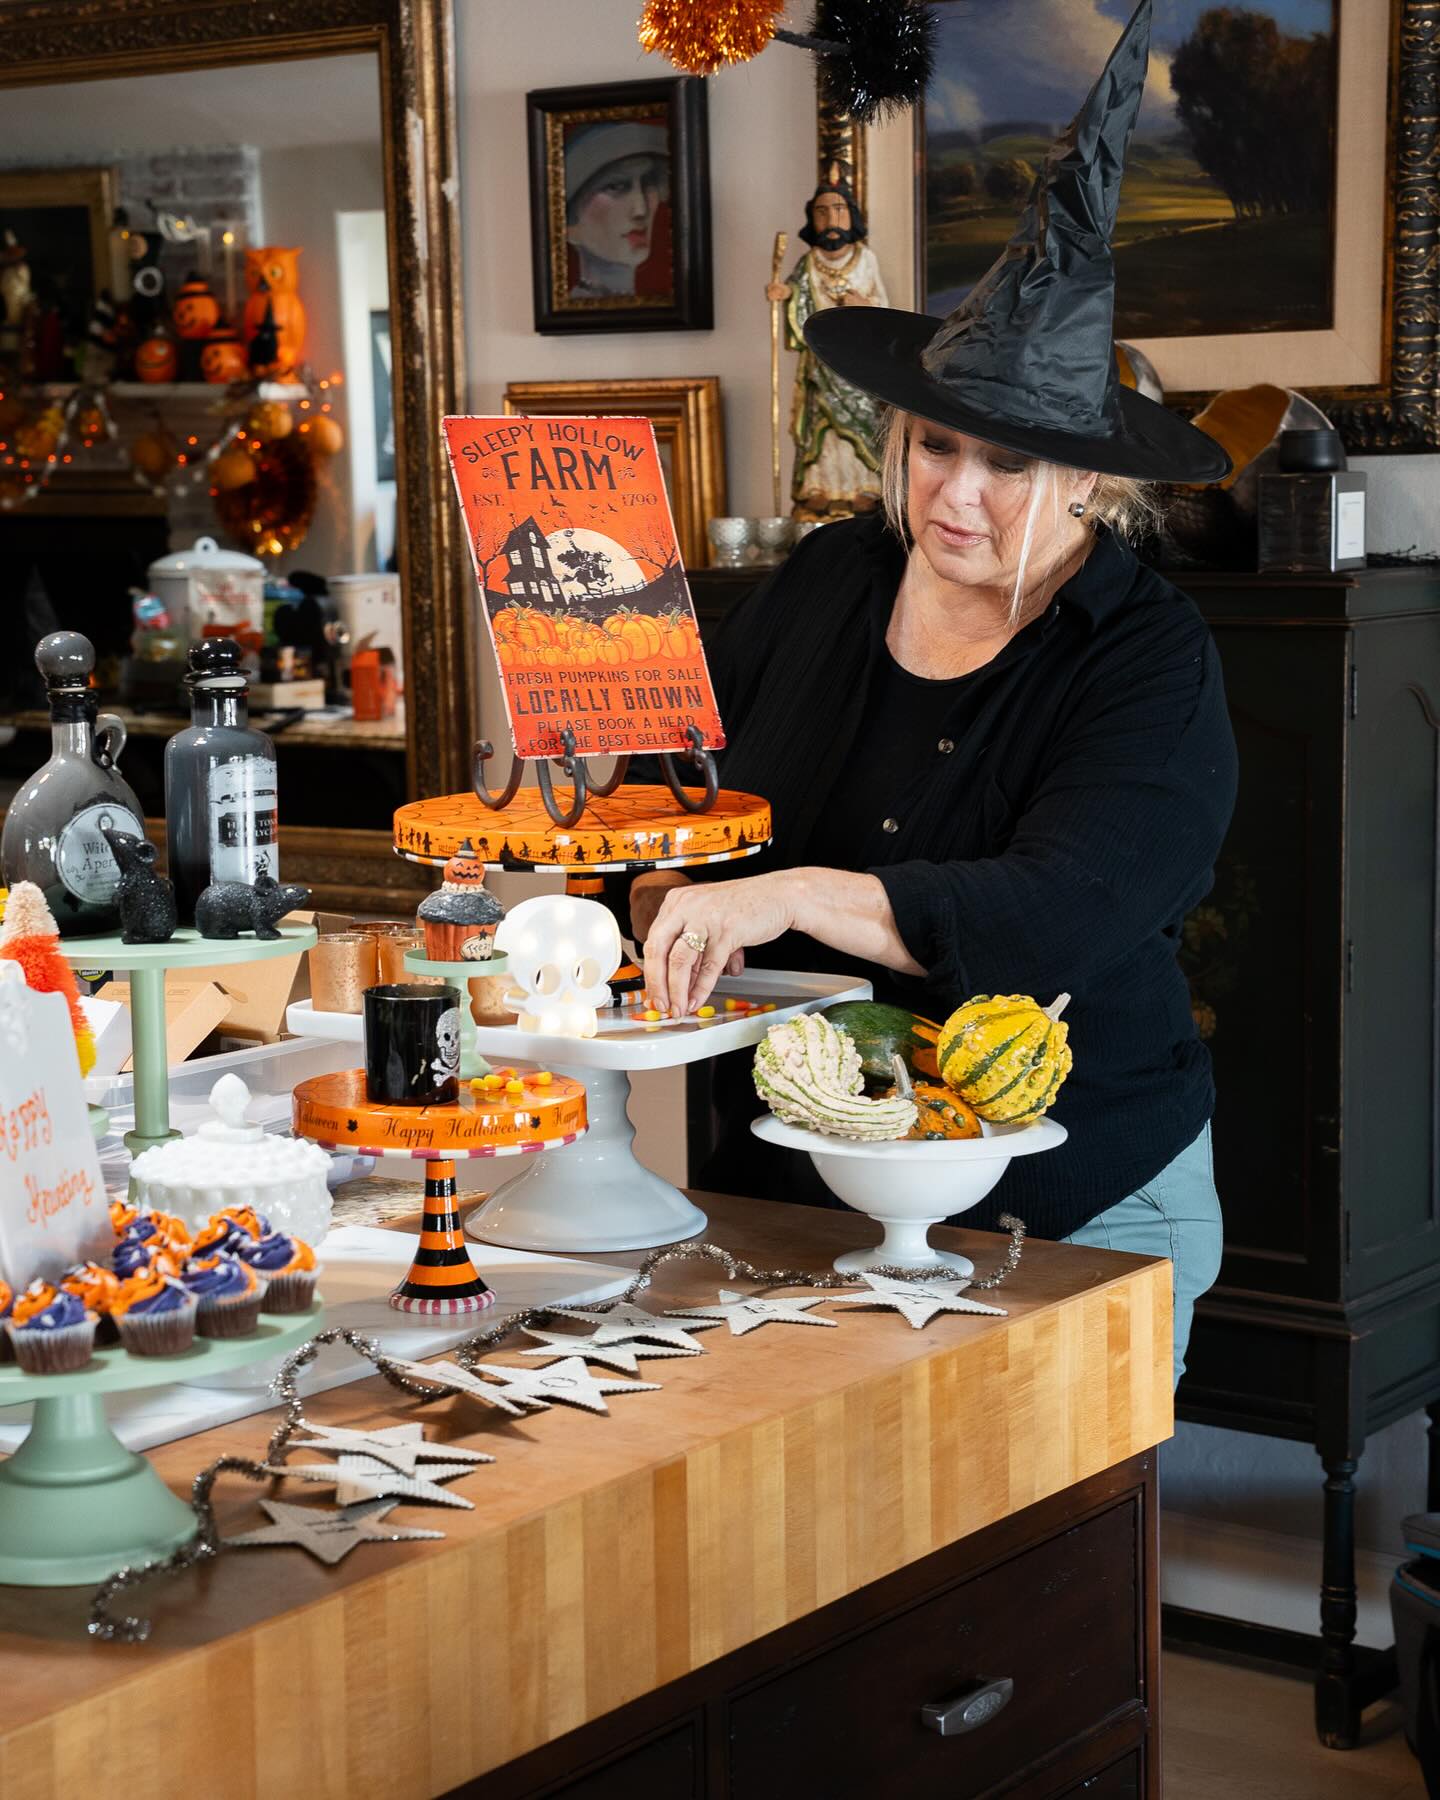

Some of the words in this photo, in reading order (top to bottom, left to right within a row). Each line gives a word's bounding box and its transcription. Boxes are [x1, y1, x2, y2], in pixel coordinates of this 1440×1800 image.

[461, 423, 535, 464] SLEEPY
[547, 423, 645, 461] HOLLOW
[500, 446, 617, 490] FARM
[472, 494, 505, 507] EST.
[621, 494, 657, 507] 1790
[507, 671, 553, 685] FRESH
[559, 669, 630, 683] PUMPKINS
[635, 668, 661, 681] FOR
[668, 667, 702, 680] SALE
[514, 687, 613, 715] LOCALLY
[622, 684, 704, 711] GROWN
[537, 718, 592, 734] PLEASE
[598, 717, 636, 730] BOOK
[643, 716, 652, 729] A
[658, 714, 695, 728] HEAD
[529, 736, 559, 751] FOR
[598, 733, 630, 747] BEST
[82, 857, 115, 873] Aper
[383, 1117, 434, 1147] Happy
[446, 1117, 522, 1138] Halloween
